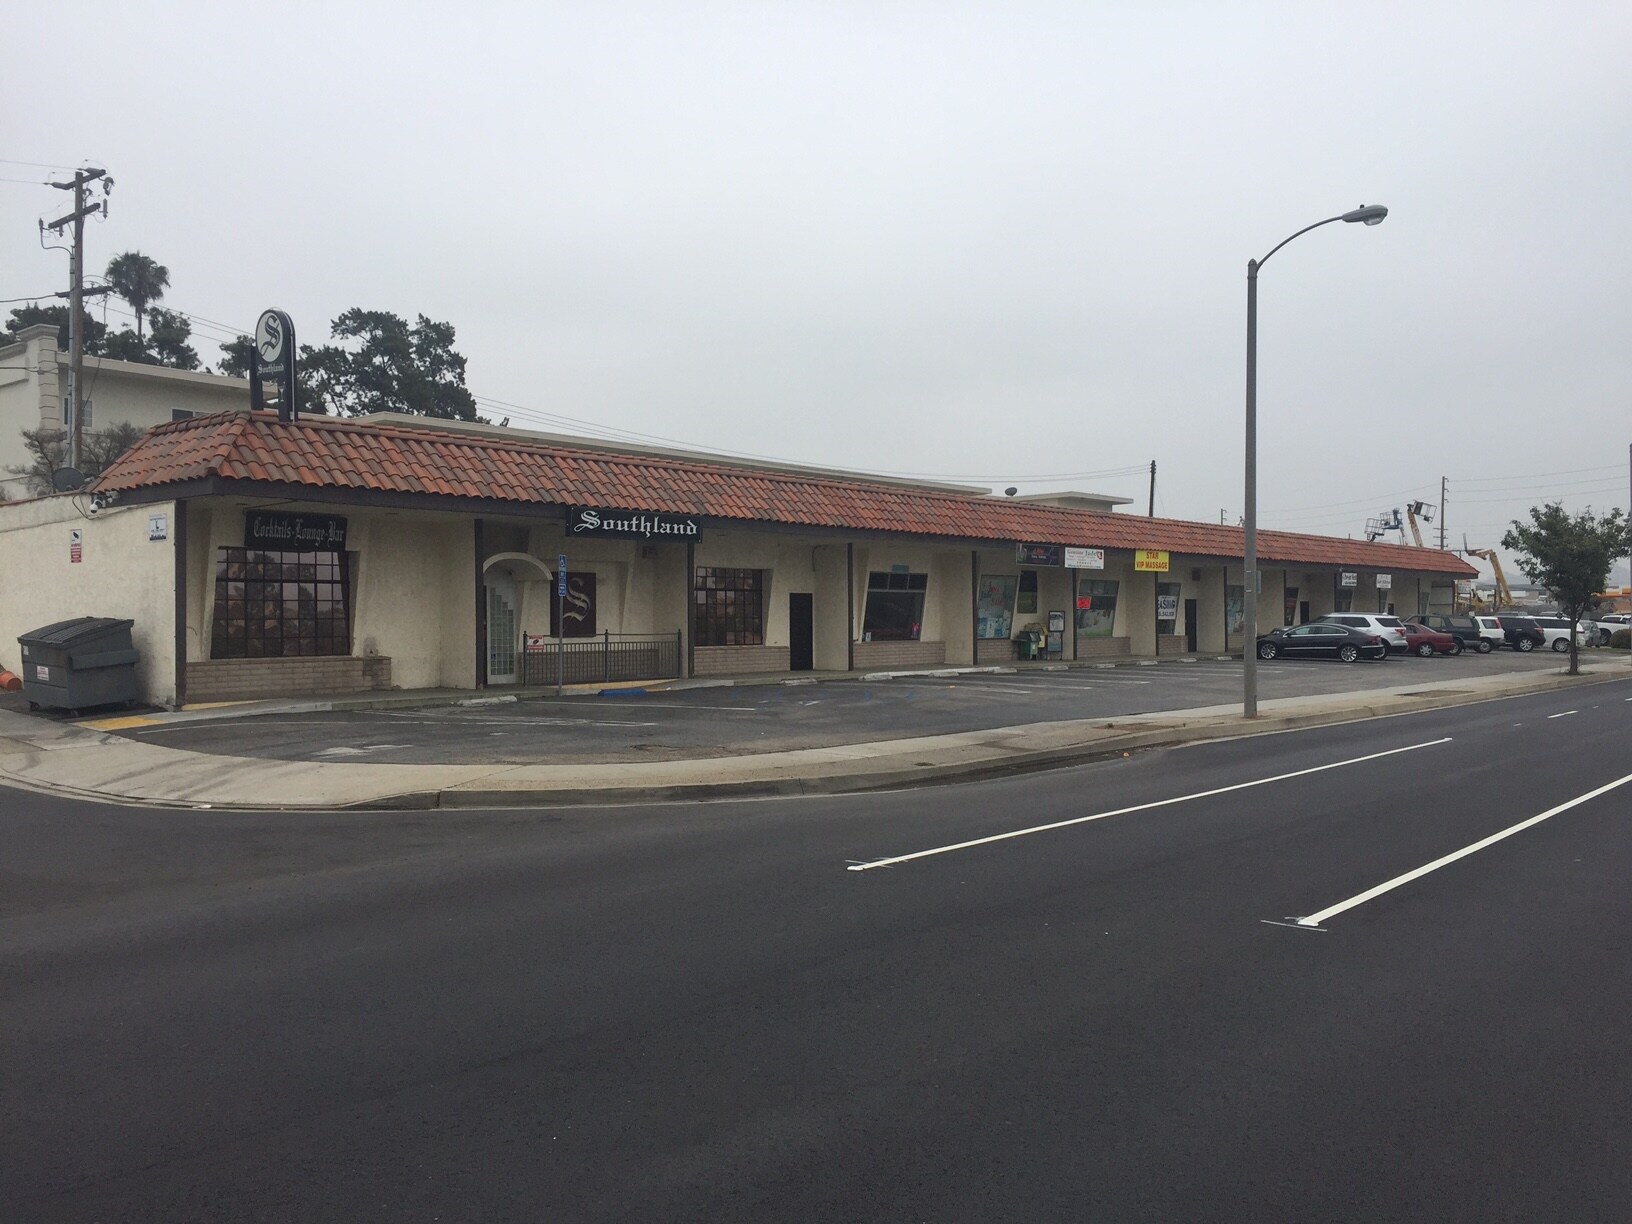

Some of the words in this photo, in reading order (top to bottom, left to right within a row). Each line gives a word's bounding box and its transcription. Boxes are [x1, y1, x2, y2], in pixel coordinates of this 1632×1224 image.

[260, 314, 281, 357] S
[573, 510, 698, 538] Southland
[1146, 551, 1159, 559] STAR
[1145, 561, 1168, 569] MASSAGE
